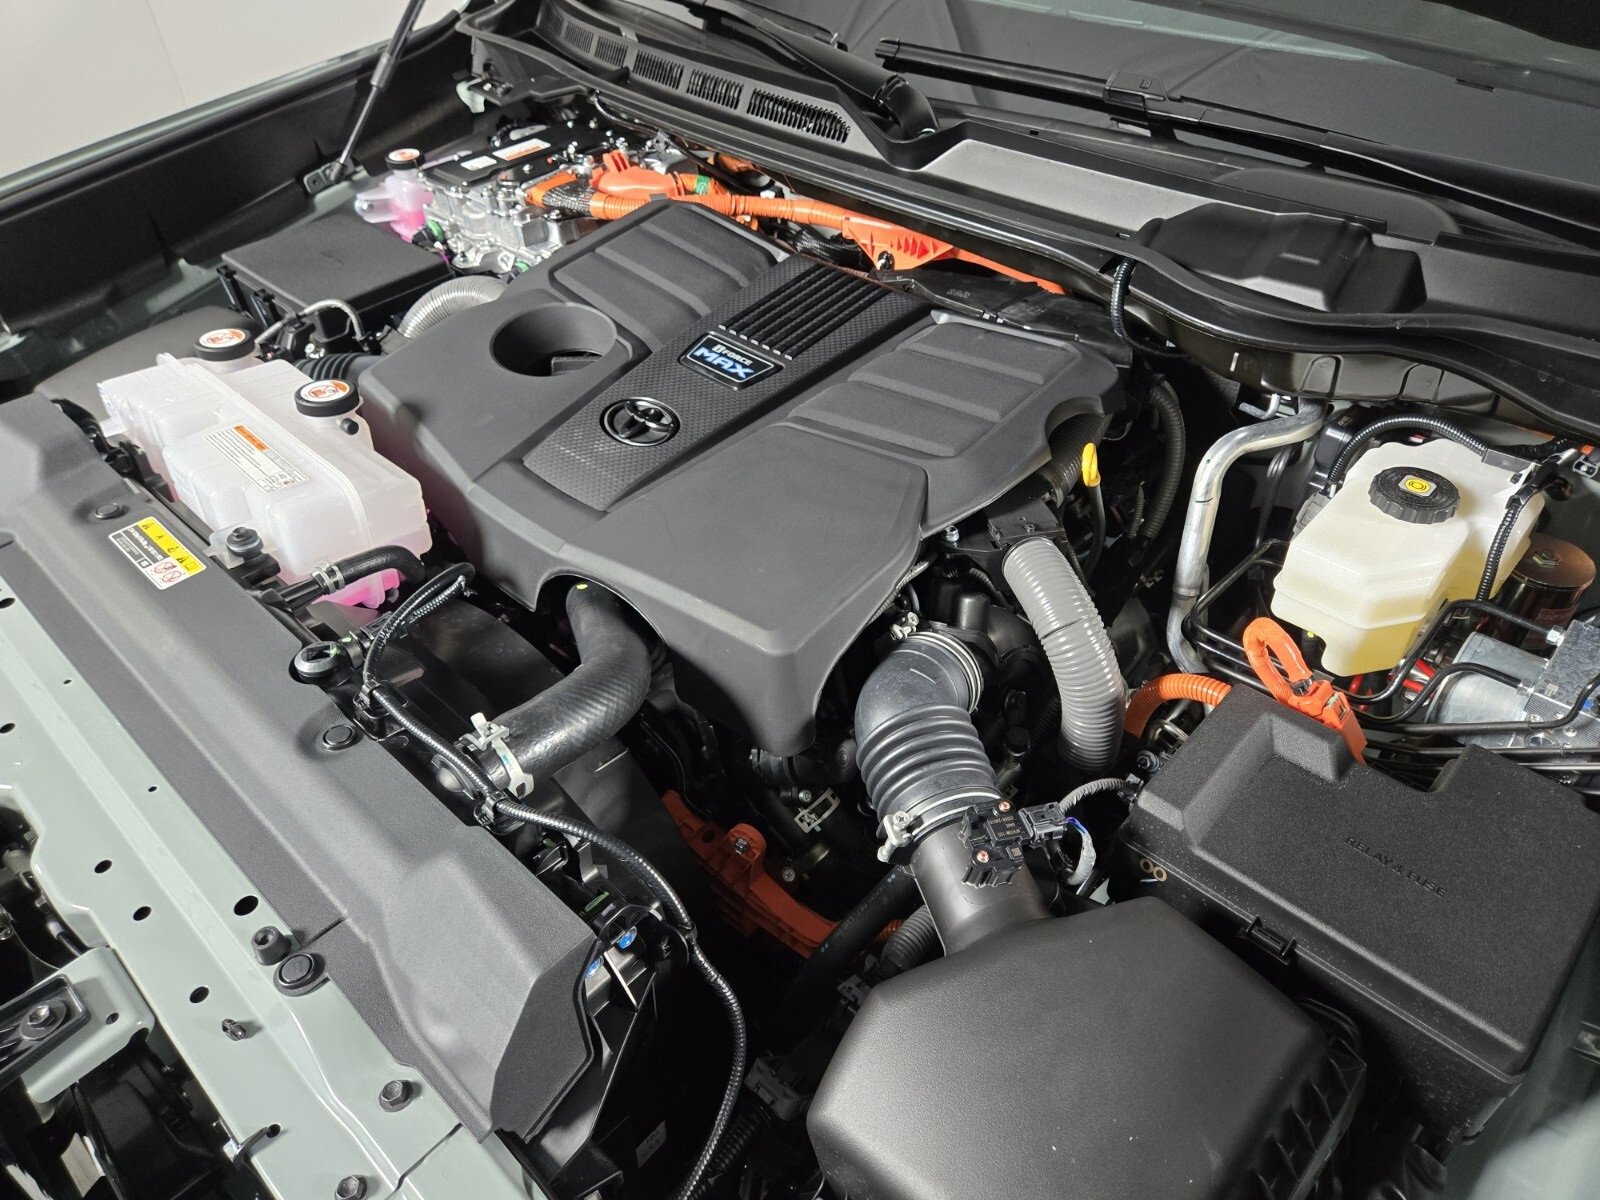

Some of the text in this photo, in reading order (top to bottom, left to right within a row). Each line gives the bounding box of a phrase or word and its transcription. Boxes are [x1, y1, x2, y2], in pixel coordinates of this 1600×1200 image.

[693, 347, 754, 378] MAX
[1345, 838, 1393, 866] RELAY
[1406, 870, 1448, 899] FUSE
